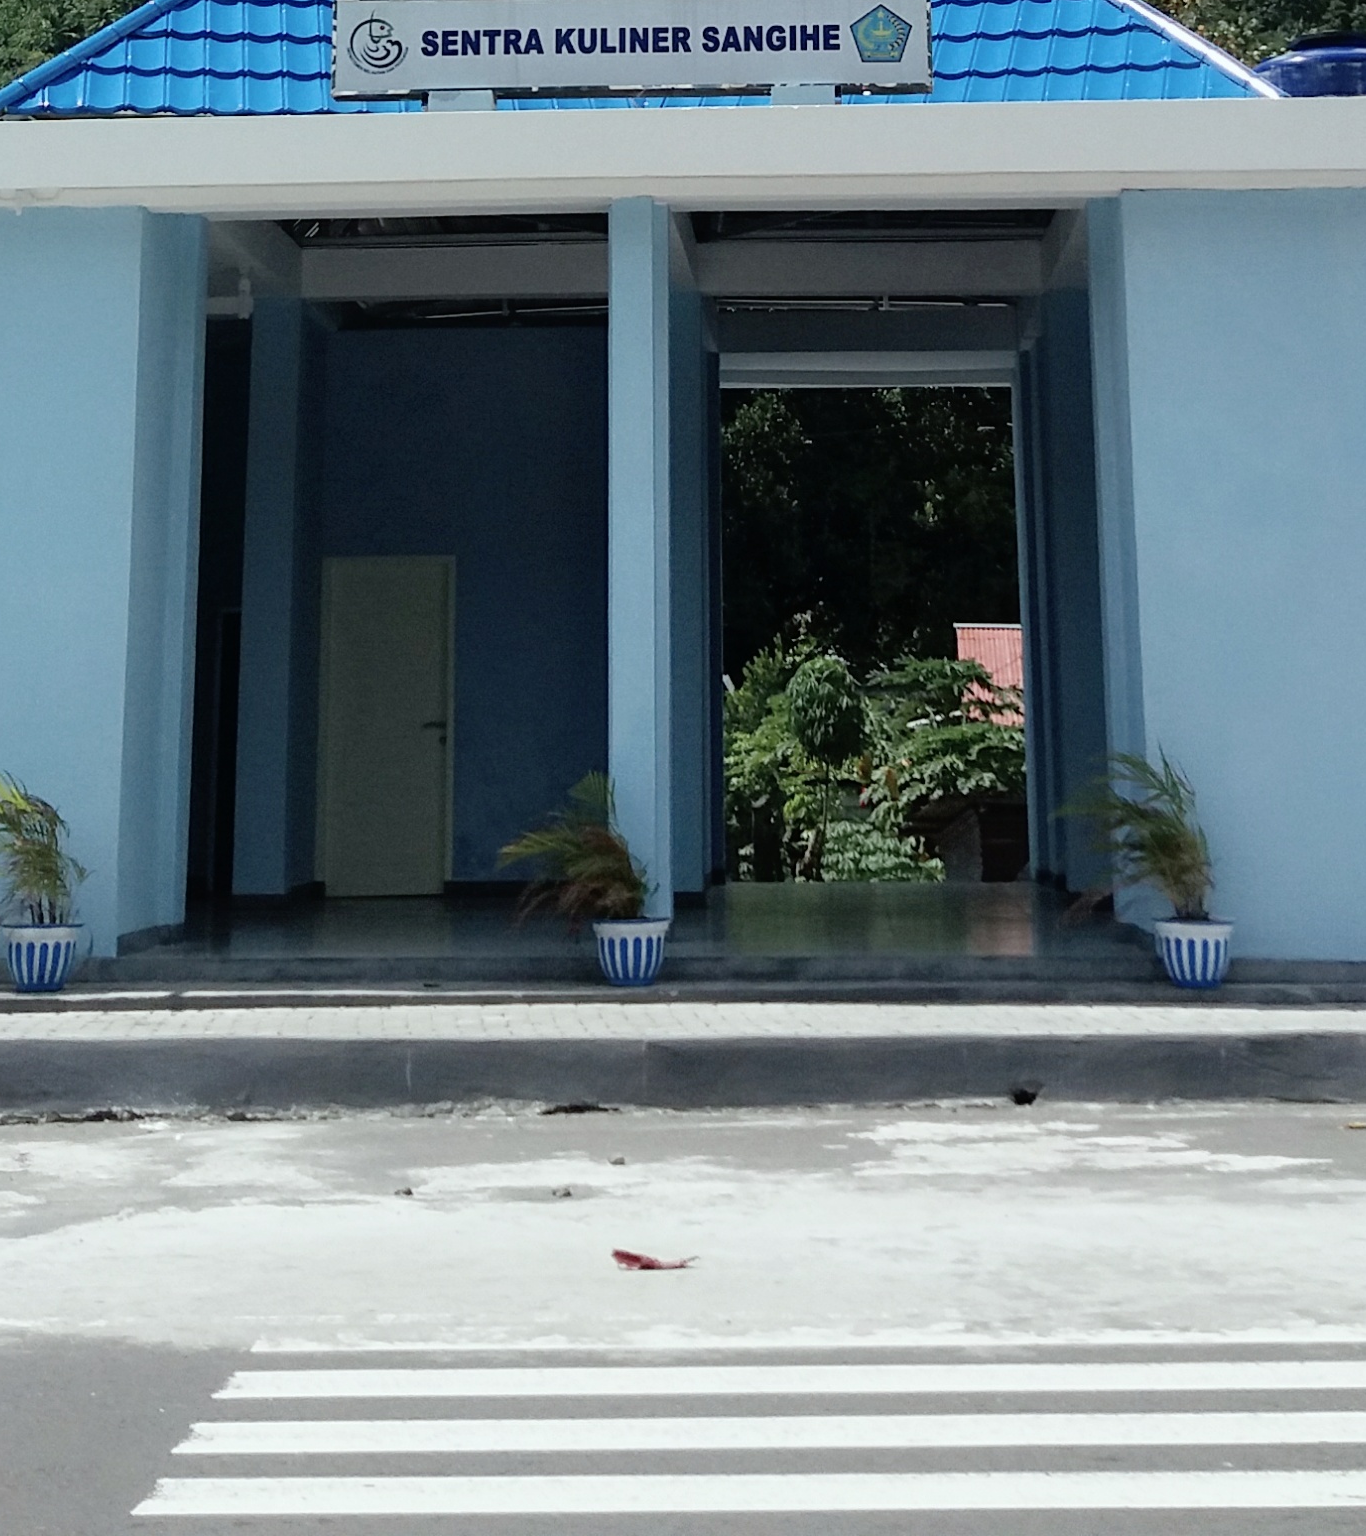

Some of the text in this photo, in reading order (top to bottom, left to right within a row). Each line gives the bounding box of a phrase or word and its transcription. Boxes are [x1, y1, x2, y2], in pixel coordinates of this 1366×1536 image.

[420, 24, 841, 57] SENTRA KULINER SANGIHE
